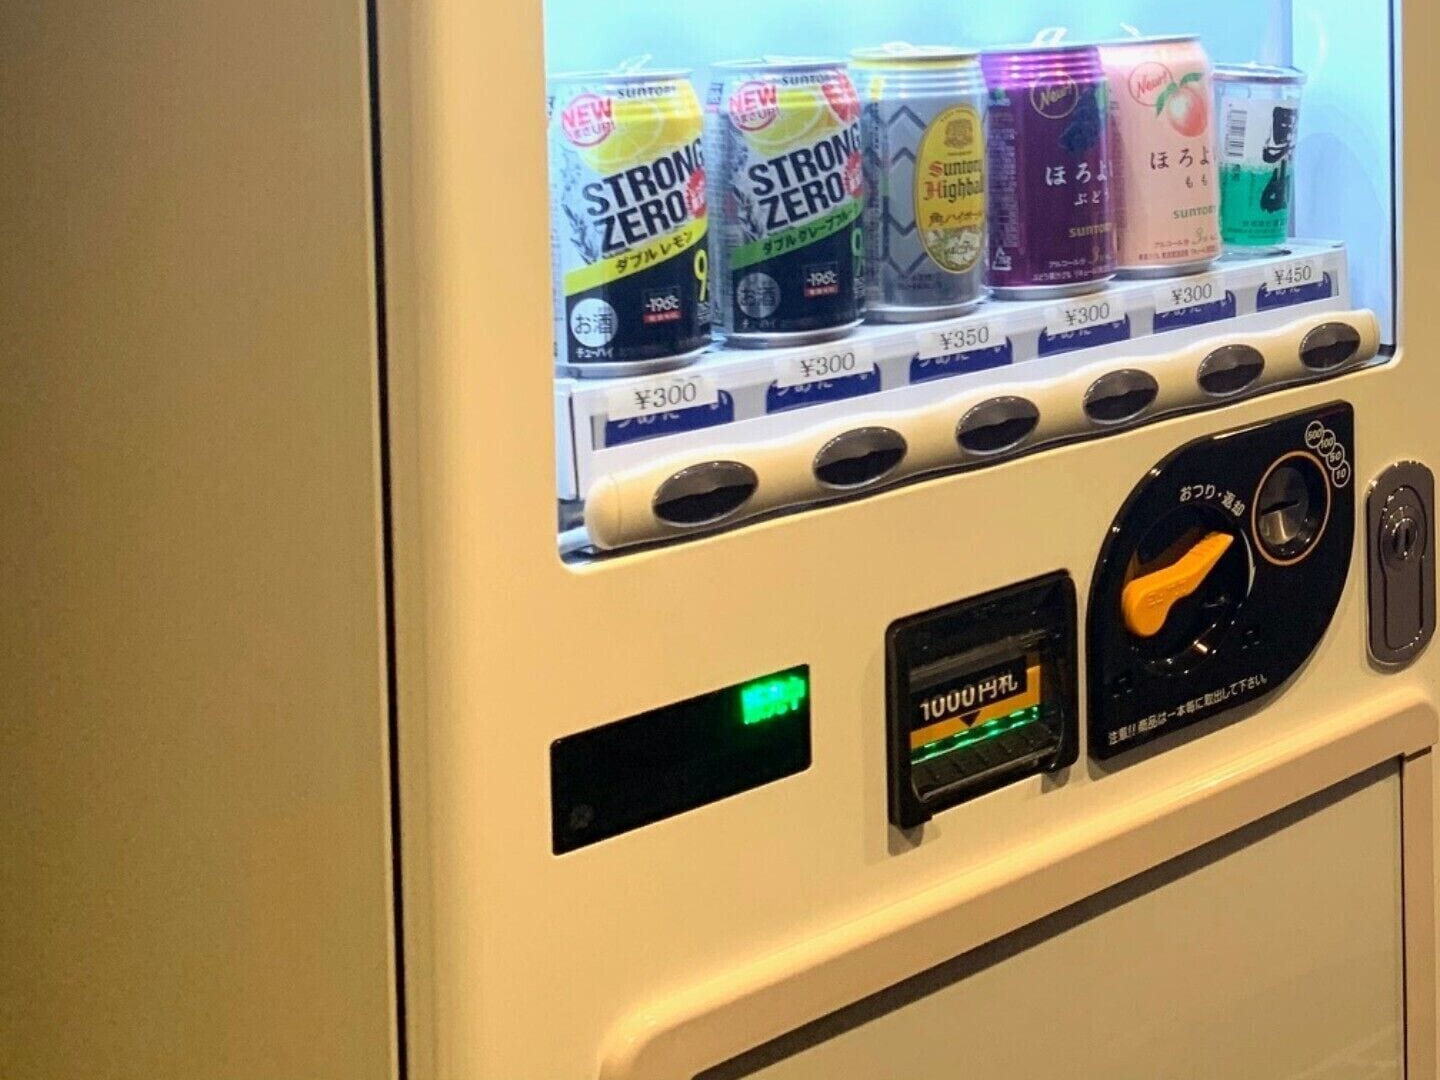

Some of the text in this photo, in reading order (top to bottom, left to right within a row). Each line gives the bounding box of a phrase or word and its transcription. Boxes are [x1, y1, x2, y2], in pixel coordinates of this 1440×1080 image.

[561, 97, 613, 127] NEW
[729, 85, 777, 116] NEW
[749, 123, 861, 196] STRONG
[1151, 146, 1210, 170] ほろよ
[582, 137, 705, 217] STRONG
[1185, 175, 1208, 189] もも
[759, 172, 846, 231] ZERO
[597, 189, 689, 255] ZERO
[616, 230, 694, 274] ダブルレモン
[1274, 265, 1312, 285] ¥450
[1172, 283, 1213, 305] ¥300
[574, 306, 614, 336] お酒
[1065, 303, 1110, 326] ¥300
[940, 326, 990, 351] ¥350
[800, 352, 856, 377] ¥300
[635, 383, 697, 411] ¥300
[1330, 451, 1342, 462] 50
[1337, 468, 1347, 479] 10
[919, 672, 1019, 723] 1000円札
